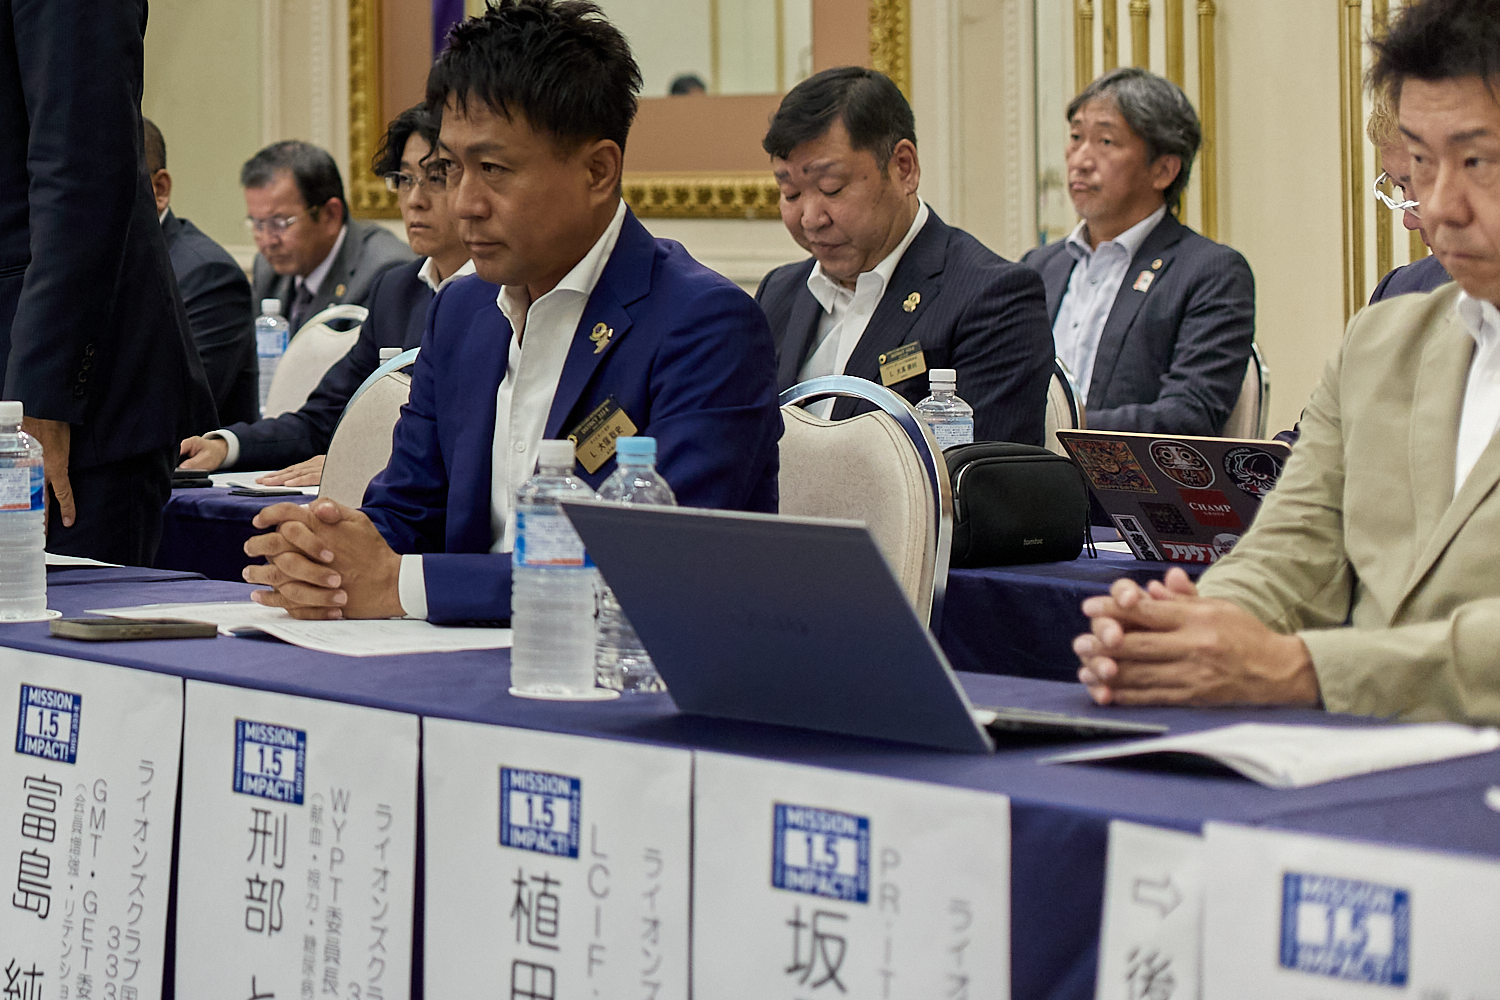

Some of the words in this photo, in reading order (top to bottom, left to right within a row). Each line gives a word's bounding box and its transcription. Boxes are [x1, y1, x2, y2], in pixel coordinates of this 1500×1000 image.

[1188, 502, 1231, 513] CHAMP
[29, 687, 73, 709] MISSION
[38, 709, 59, 738] 1.5
[244, 721, 297, 748] MISSION
[24, 735, 69, 760] IMPACT!
[258, 747, 282, 776] 1.5
[242, 774, 296, 801] IMPACT!
[510, 769, 571, 797] MISSION
[528, 798, 554, 828] 1.5
[12, 774, 63, 919] 富島
[246, 807, 287, 937] 刑部
